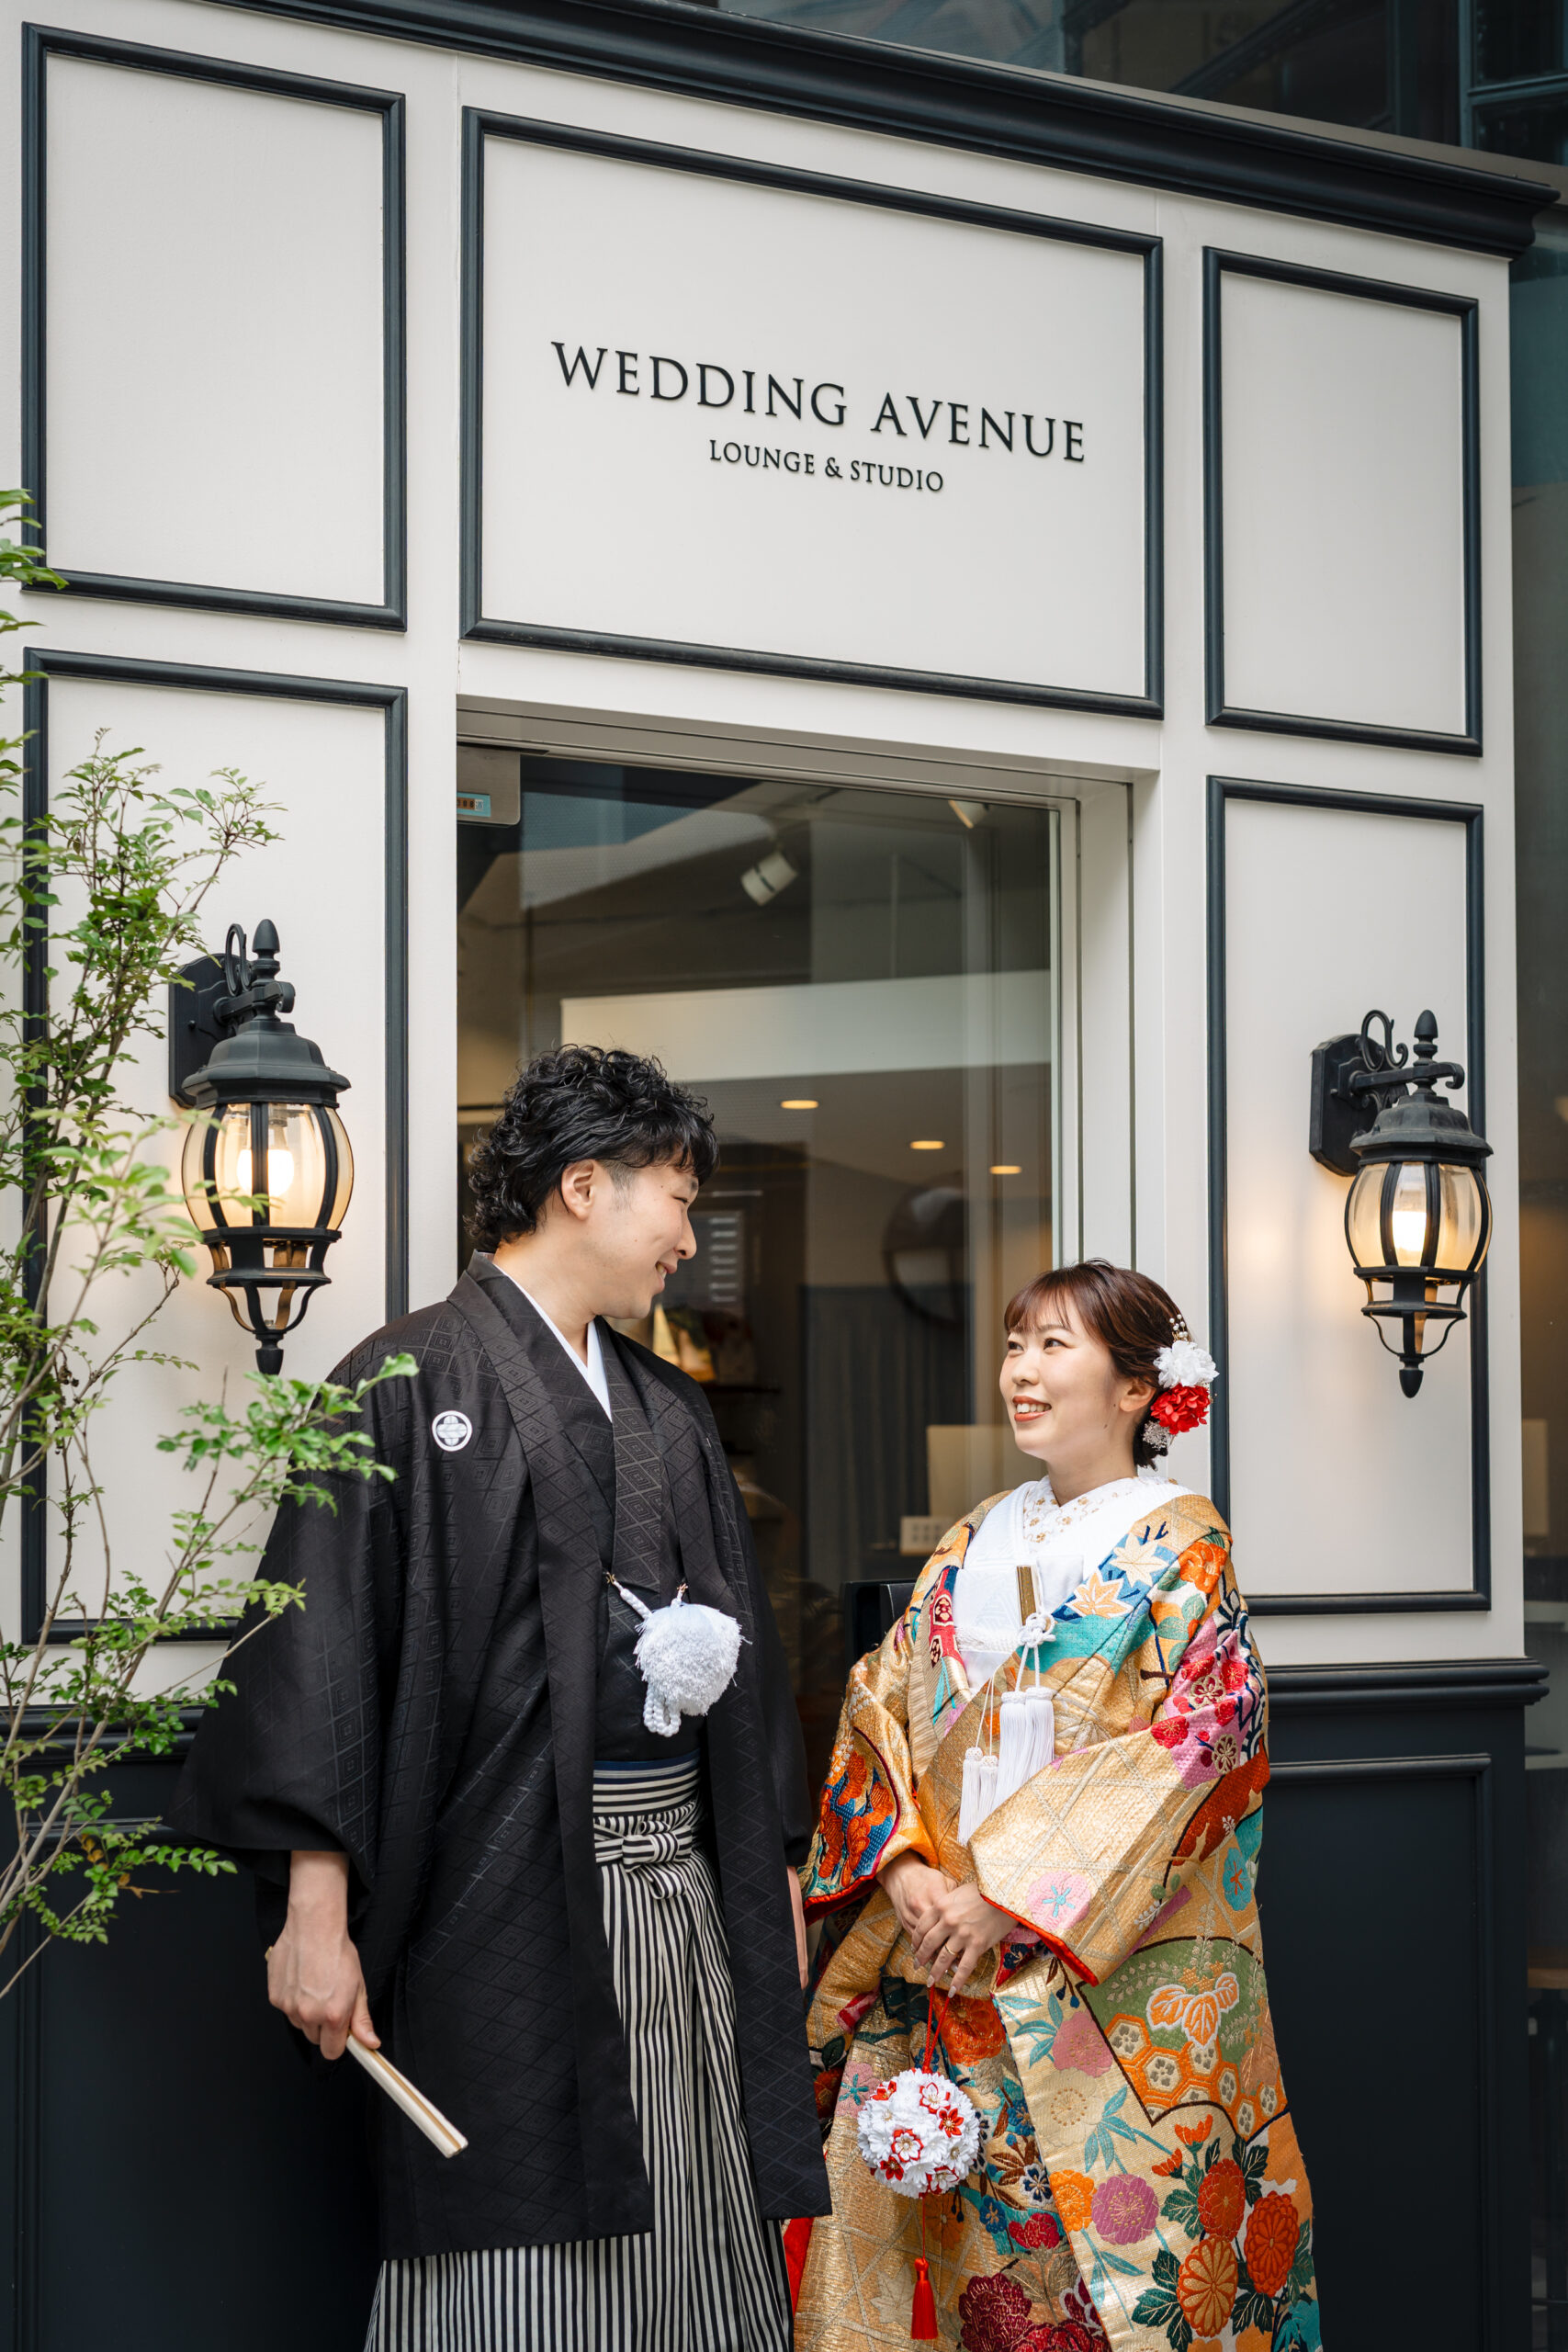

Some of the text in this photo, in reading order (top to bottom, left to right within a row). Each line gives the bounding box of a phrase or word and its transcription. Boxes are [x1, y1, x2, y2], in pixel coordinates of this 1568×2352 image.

[550, 341, 1085, 463] WEDDING AVENUE
[709, 439, 943, 492] LOUNGE & STUDIO
